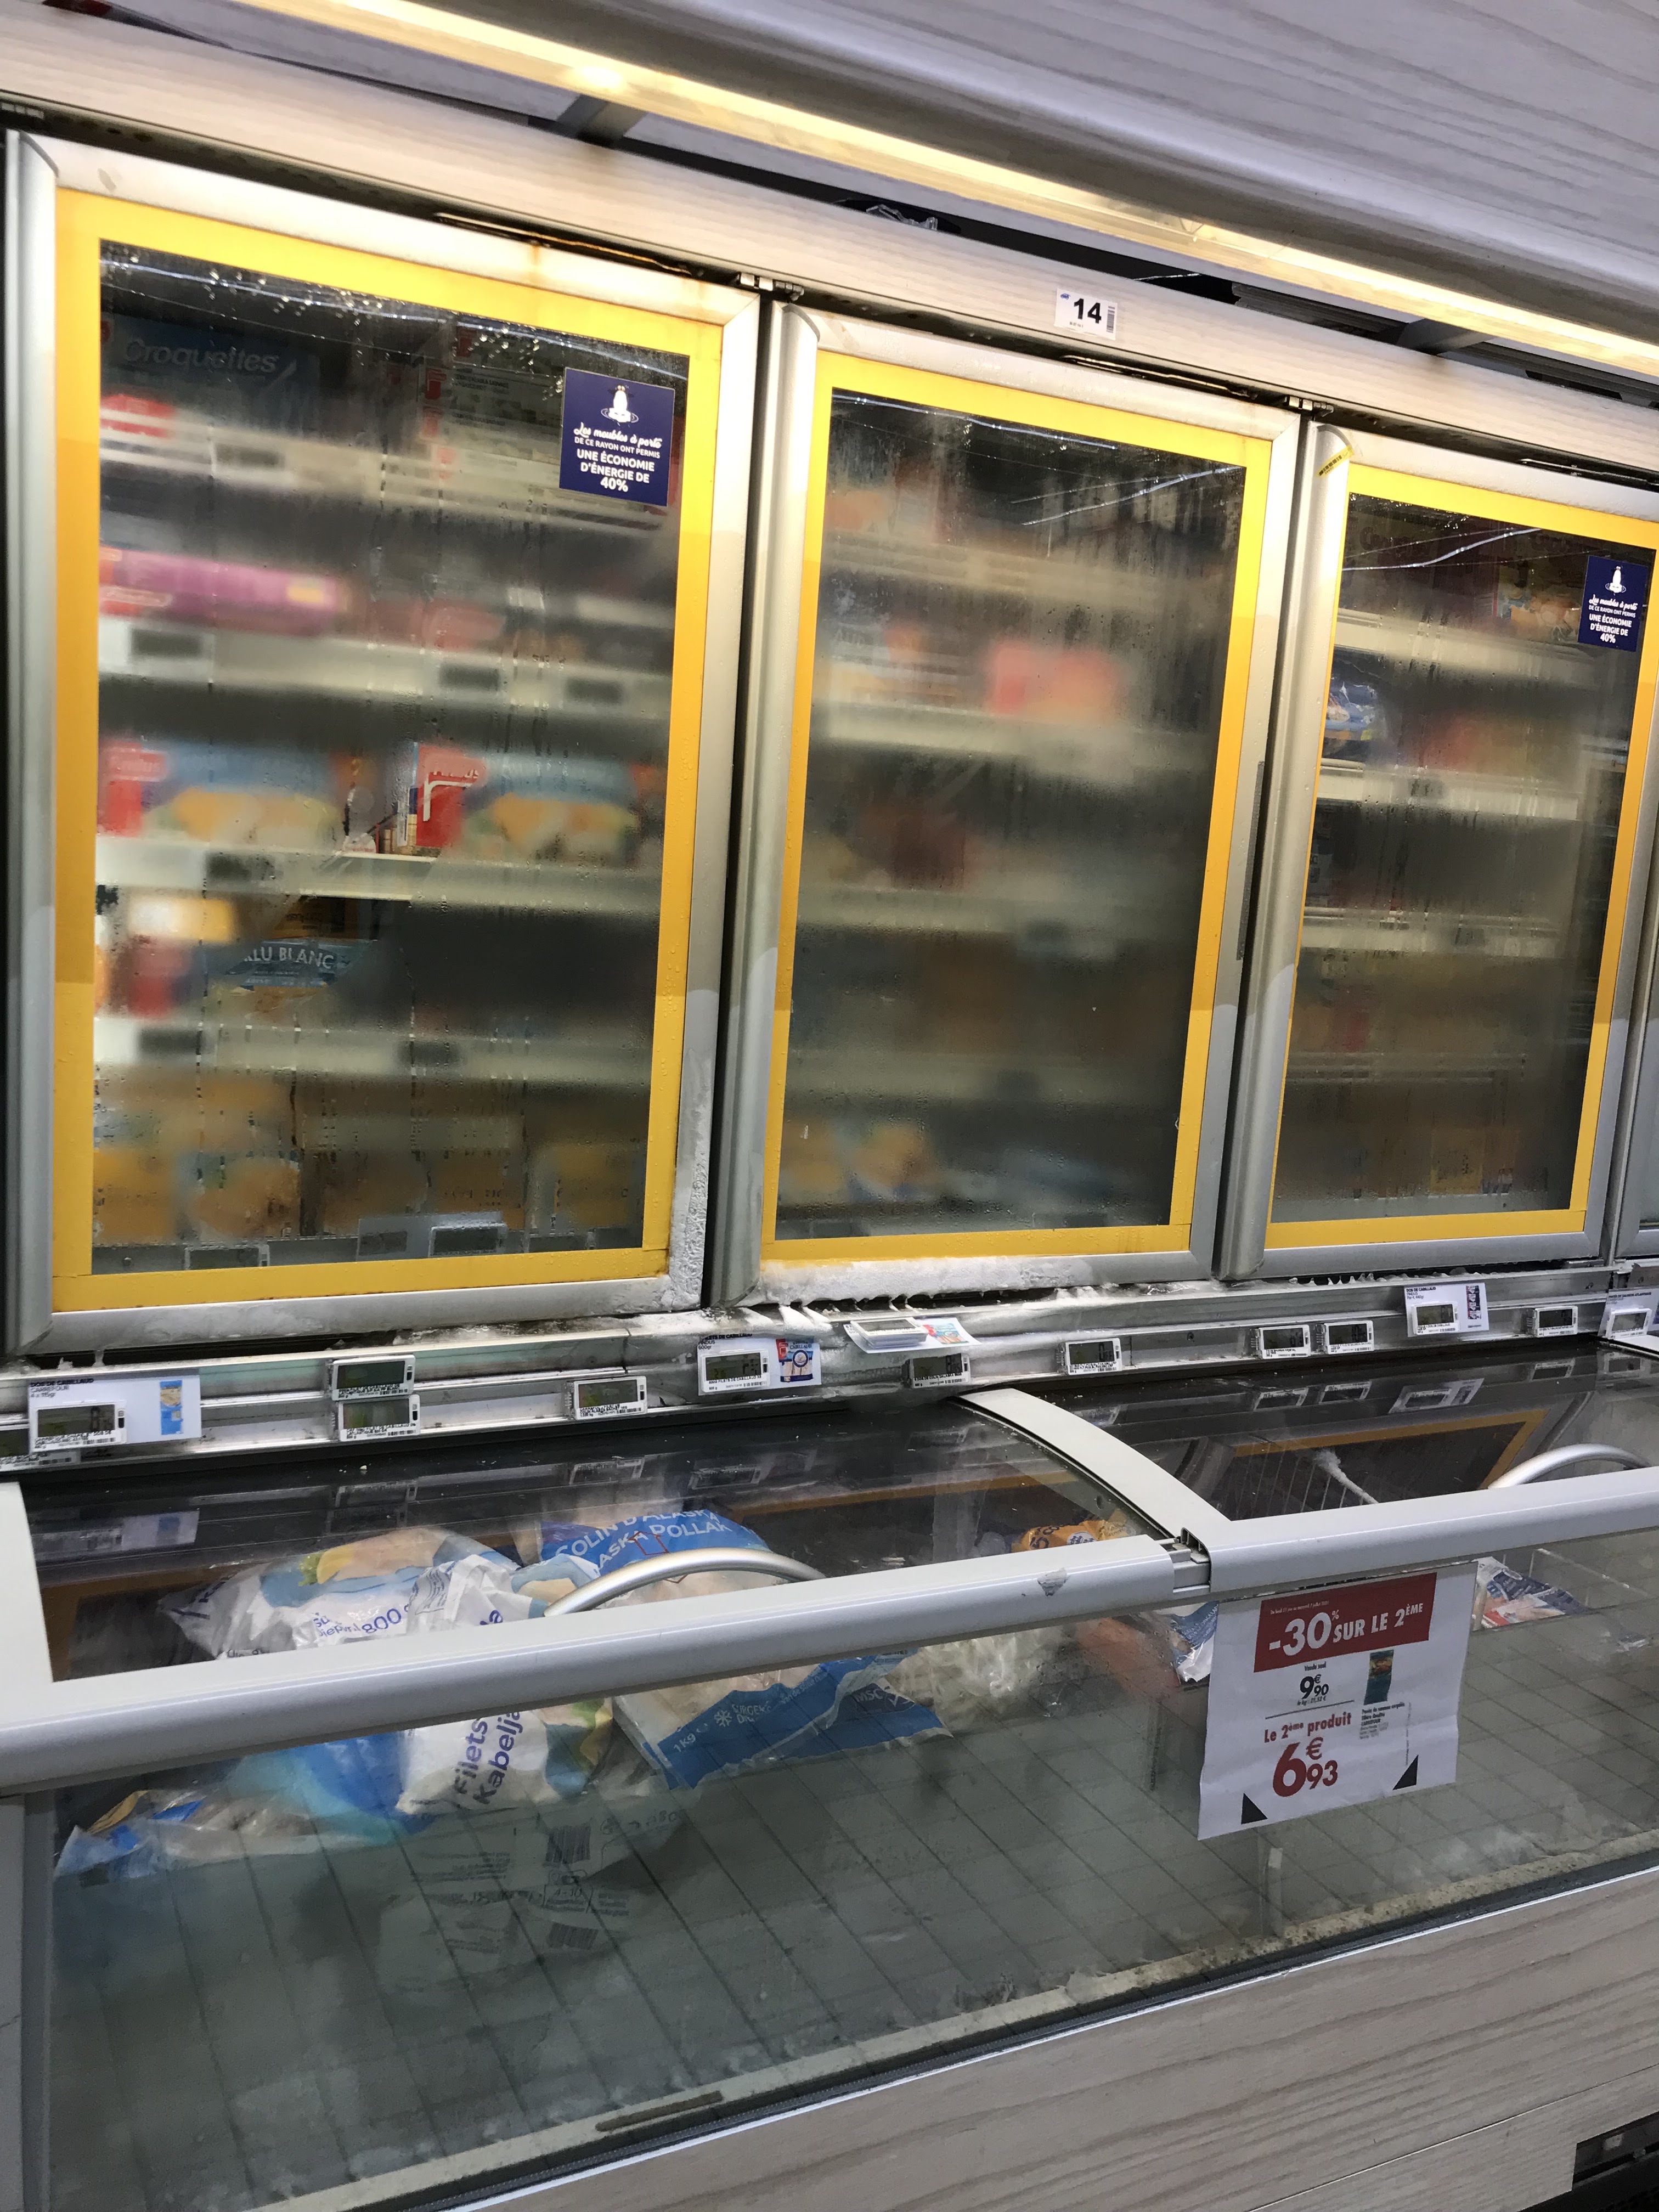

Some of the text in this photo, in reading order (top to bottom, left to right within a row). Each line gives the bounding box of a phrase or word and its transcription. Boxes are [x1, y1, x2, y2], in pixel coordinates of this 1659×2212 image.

[1074, 298, 1102, 324] 14
[126, 338, 279, 375] Croquettes
[574, 422, 591, 438] Les
[630, 435, 637, 444] à
[577, 449, 654, 472] UNE ÉCONOMIE
[596, 440, 619, 450] RAYON
[620, 445, 634, 454] ONT
[636, 448, 661, 459] PERMIS
[580, 462, 650, 483] D'ÉNERGIE DE
[600, 477, 628, 492] 40%
[1589, 594, 1599, 606] Les
[1589, 613, 1632, 628] UNE ÉCONOMIE
[1590, 623, 1628, 636] D'ÉNERGIE DE
[1600, 633, 1616, 644] 40%
[279, 947, 334, 969] BLANC
[362, 1609, 402, 1634] 800
[1333, 1619, 1365, 1643] SUR
[1371, 1612, 1388, 1633] LE
[854, 1689, 883, 1702] MSC
[1265, 1729, 1277, 1743] Le
[1307, 1711, 1352, 1736] produit
[453, 1720, 488, 1794] Filets
